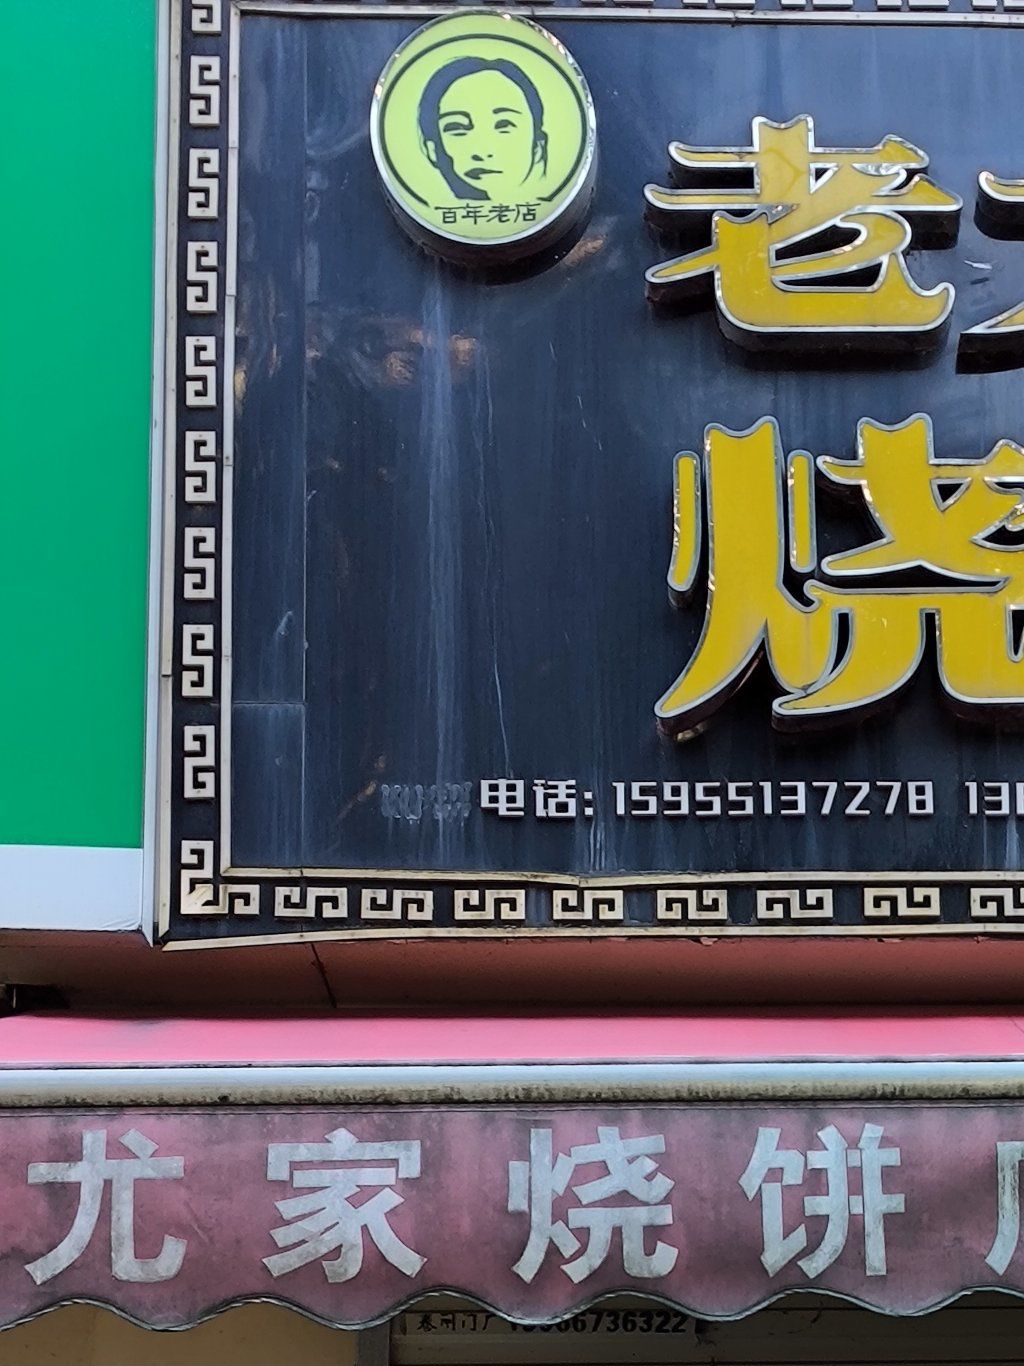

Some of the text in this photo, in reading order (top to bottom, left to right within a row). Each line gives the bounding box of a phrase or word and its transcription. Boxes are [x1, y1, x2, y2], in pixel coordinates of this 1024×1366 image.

[434, 202, 541, 225] 百年老店
[511, 1309, 687, 1333] 6736322
